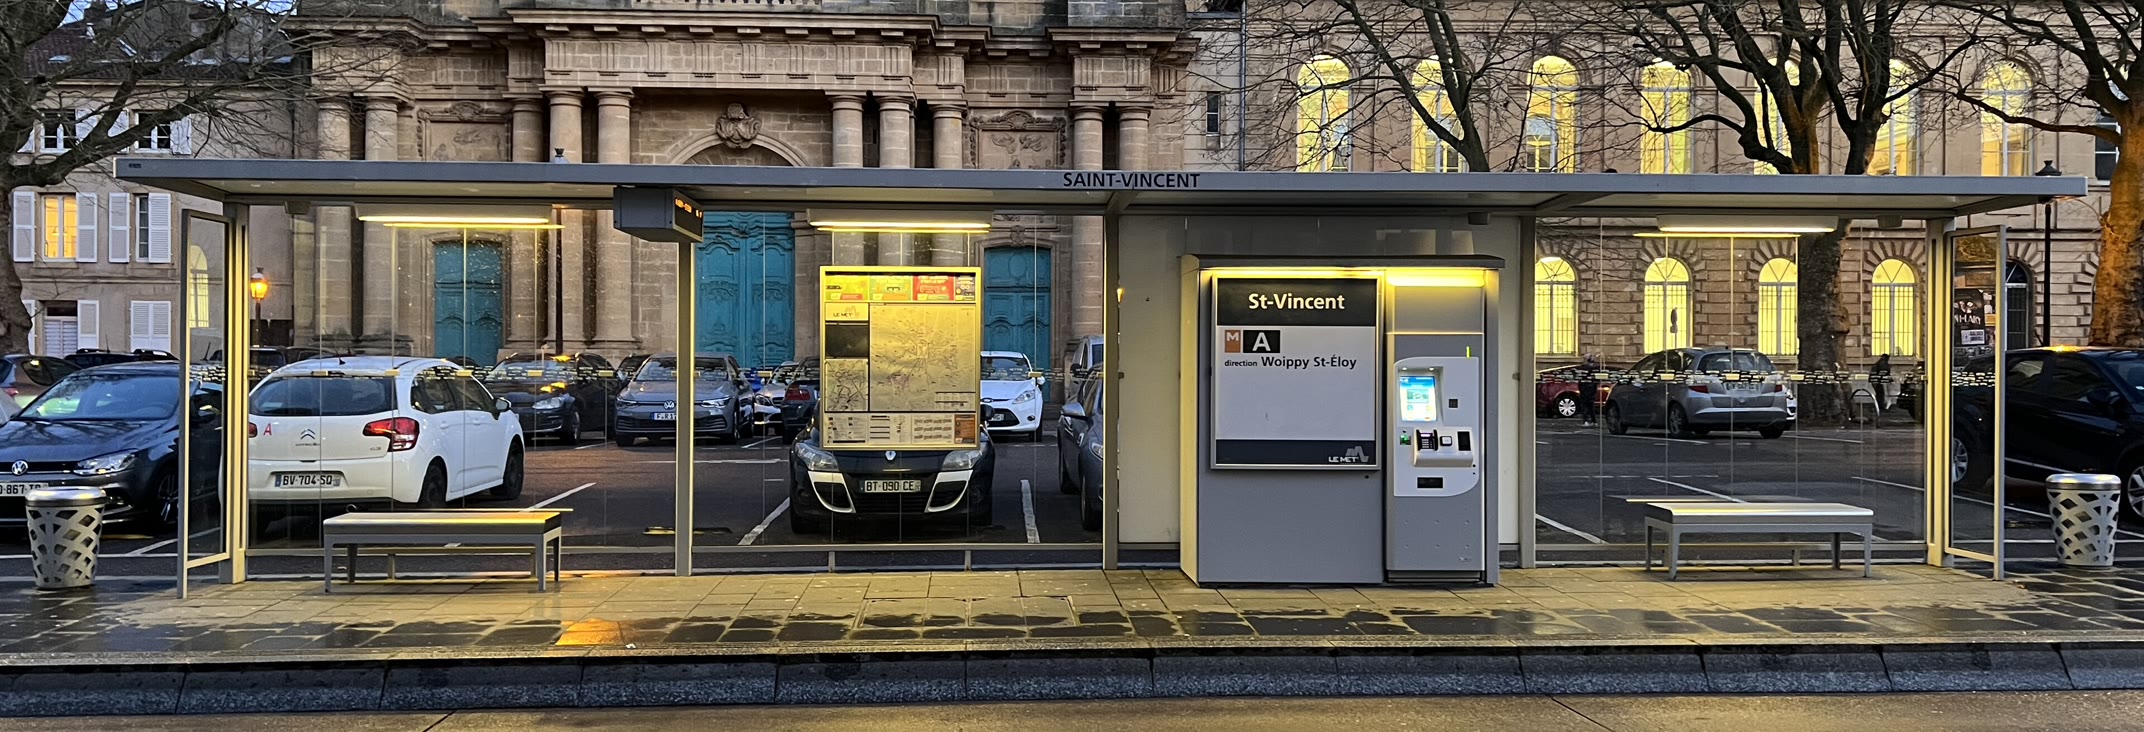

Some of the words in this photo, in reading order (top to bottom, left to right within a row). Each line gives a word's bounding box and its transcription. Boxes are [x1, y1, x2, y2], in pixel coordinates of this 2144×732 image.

[1063, 172, 1200, 188] SAINT-VINCENT
[1248, 293, 1345, 310] St-Vincent
[1226, 332, 1239, 341] M
[1252, 332, 1271, 351] A
[1261, 356, 1310, 369] Woippy
[1313, 354, 1357, 370] St-Éloy
[263, 423, 272, 435] A
